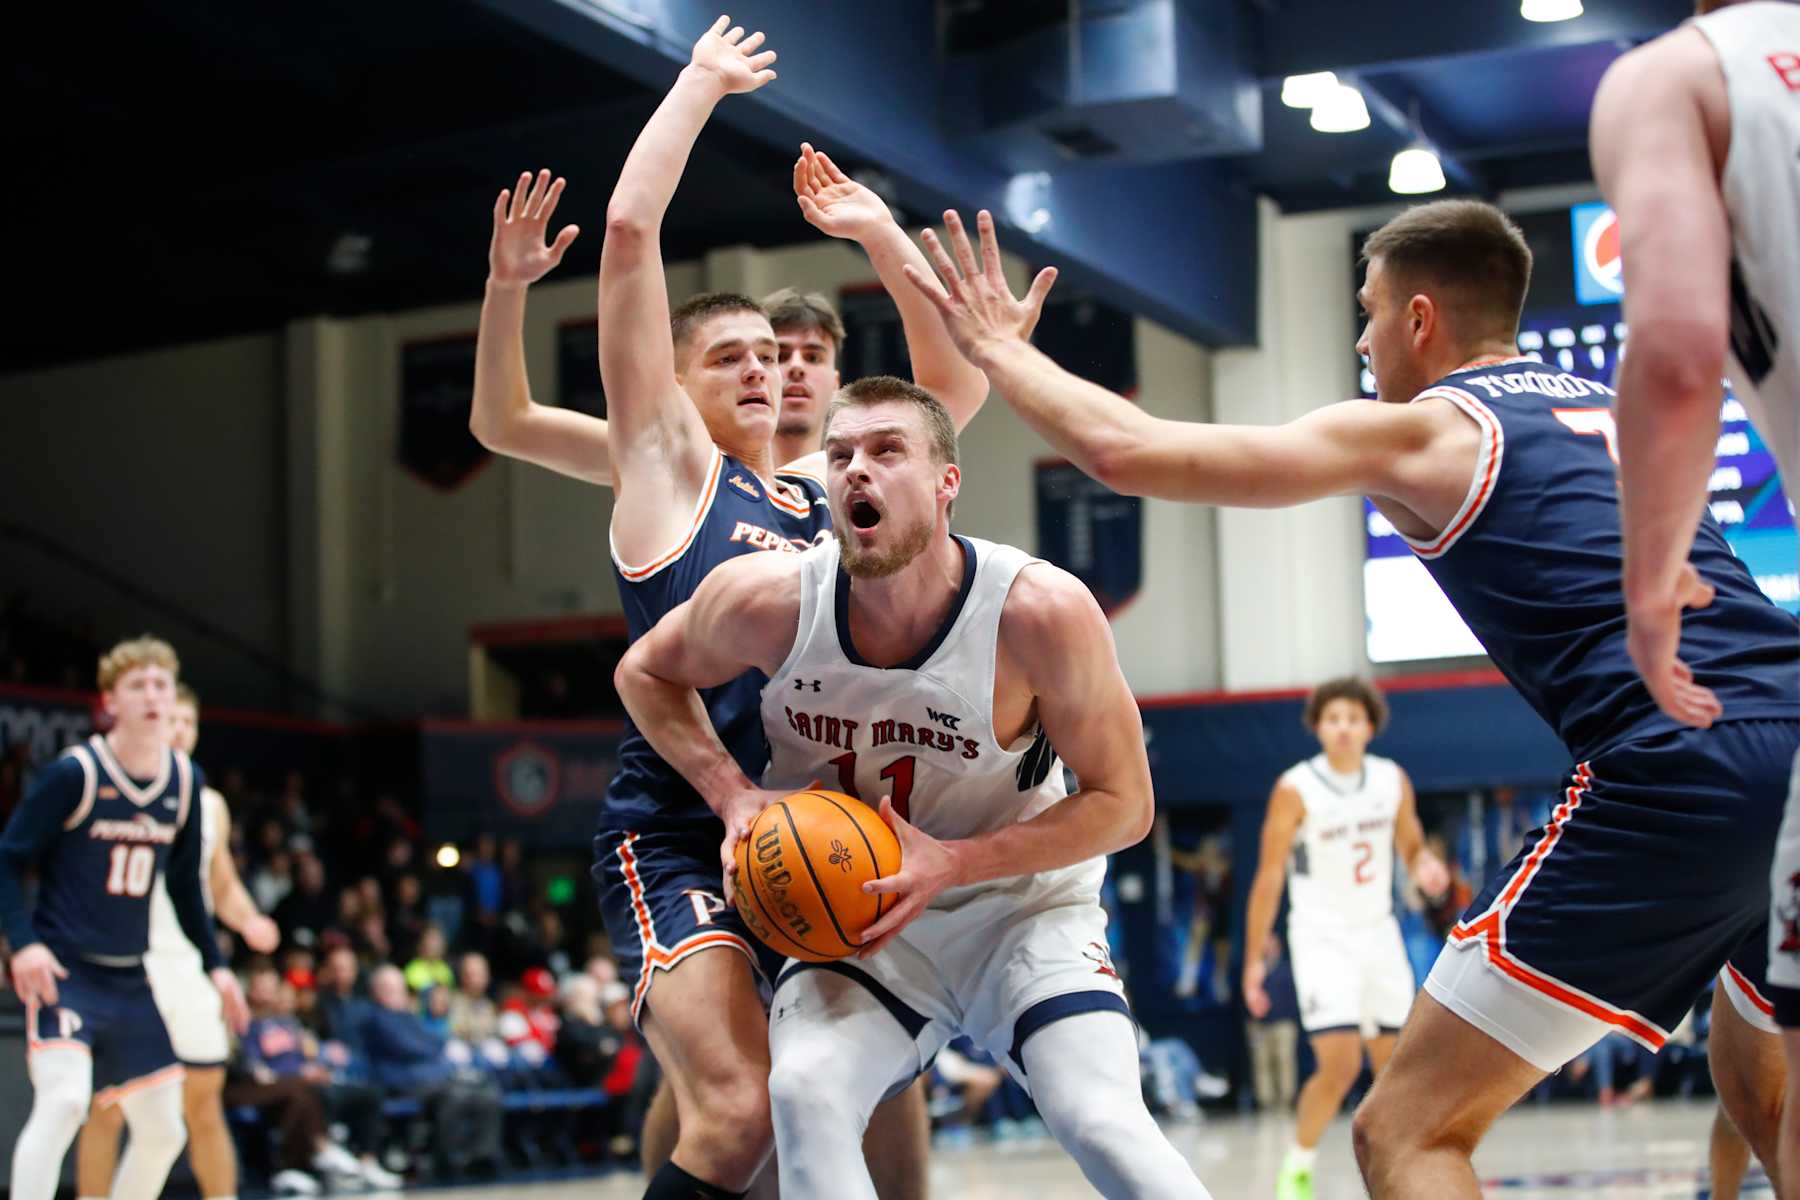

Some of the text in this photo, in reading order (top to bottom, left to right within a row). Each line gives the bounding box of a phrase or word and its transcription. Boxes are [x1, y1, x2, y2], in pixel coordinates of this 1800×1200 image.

[872, 719, 980, 760] MARY'S
[106, 844, 156, 899] 10
[1351, 840, 1375, 886] 2
